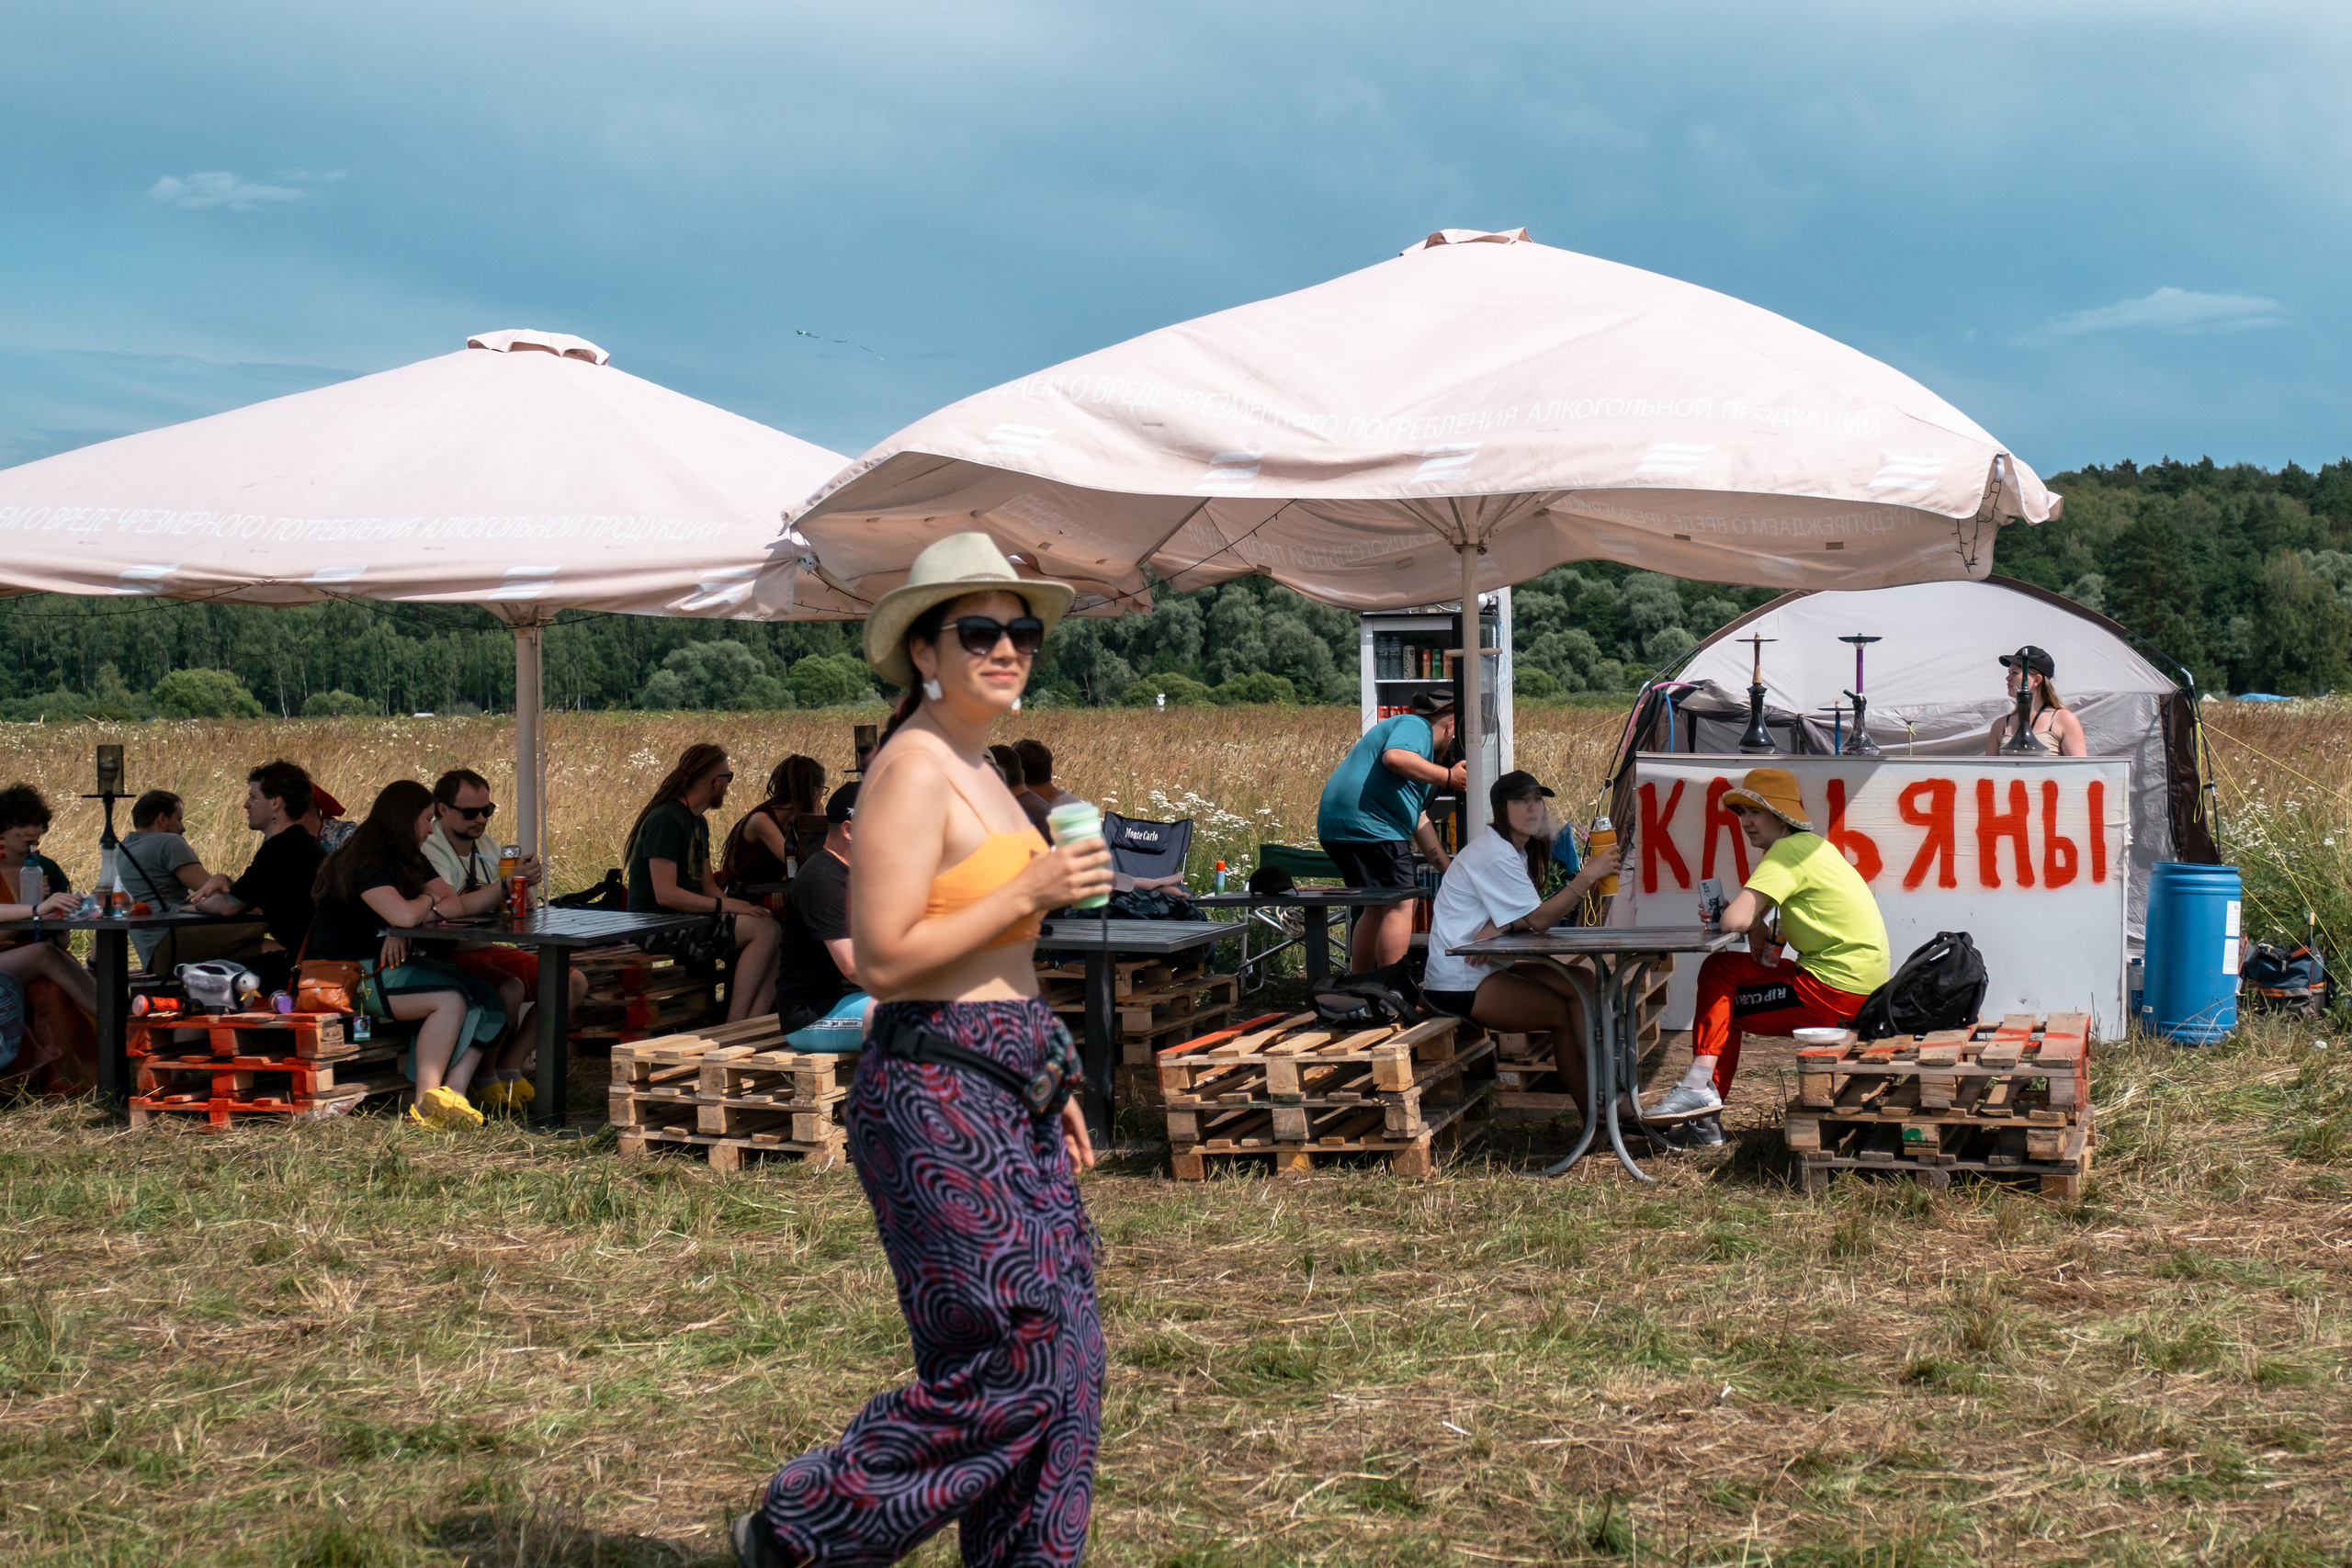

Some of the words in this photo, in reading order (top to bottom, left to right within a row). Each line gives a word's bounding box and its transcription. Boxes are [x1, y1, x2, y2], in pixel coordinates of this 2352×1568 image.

[1069, 374, 1091, 401] О
[1091, 378, 1164, 413] ВРЕДЕ
[1345, 405, 1518, 441] ПОТРЕБЛЕНИЯ
[1525, 398, 1713, 424] АЛКОГОЛЬНОЙ
[1721, 400, 1882, 436] ПРОДУКЦИИ
[23, 506, 51, 530] О
[41, 506, 119, 536] ВРЕДЕ
[117, 508, 267, 539] ЧРЕЗМЕРНОГО
[262, 516, 423, 541] ПОТРЕБЛЕНИЯ
[416, 513, 589, 540] АЛКОГОЛЬНОЙ
[582, 514, 729, 544] ПРОДУКЦИИ
[1125, 827, 1143, 840] Monte
[1142, 830, 1159, 841] Carlo
[1639, 776, 2107, 893] КАЬЯНЫ
[1763, 987, 1787, 1002] RIP
